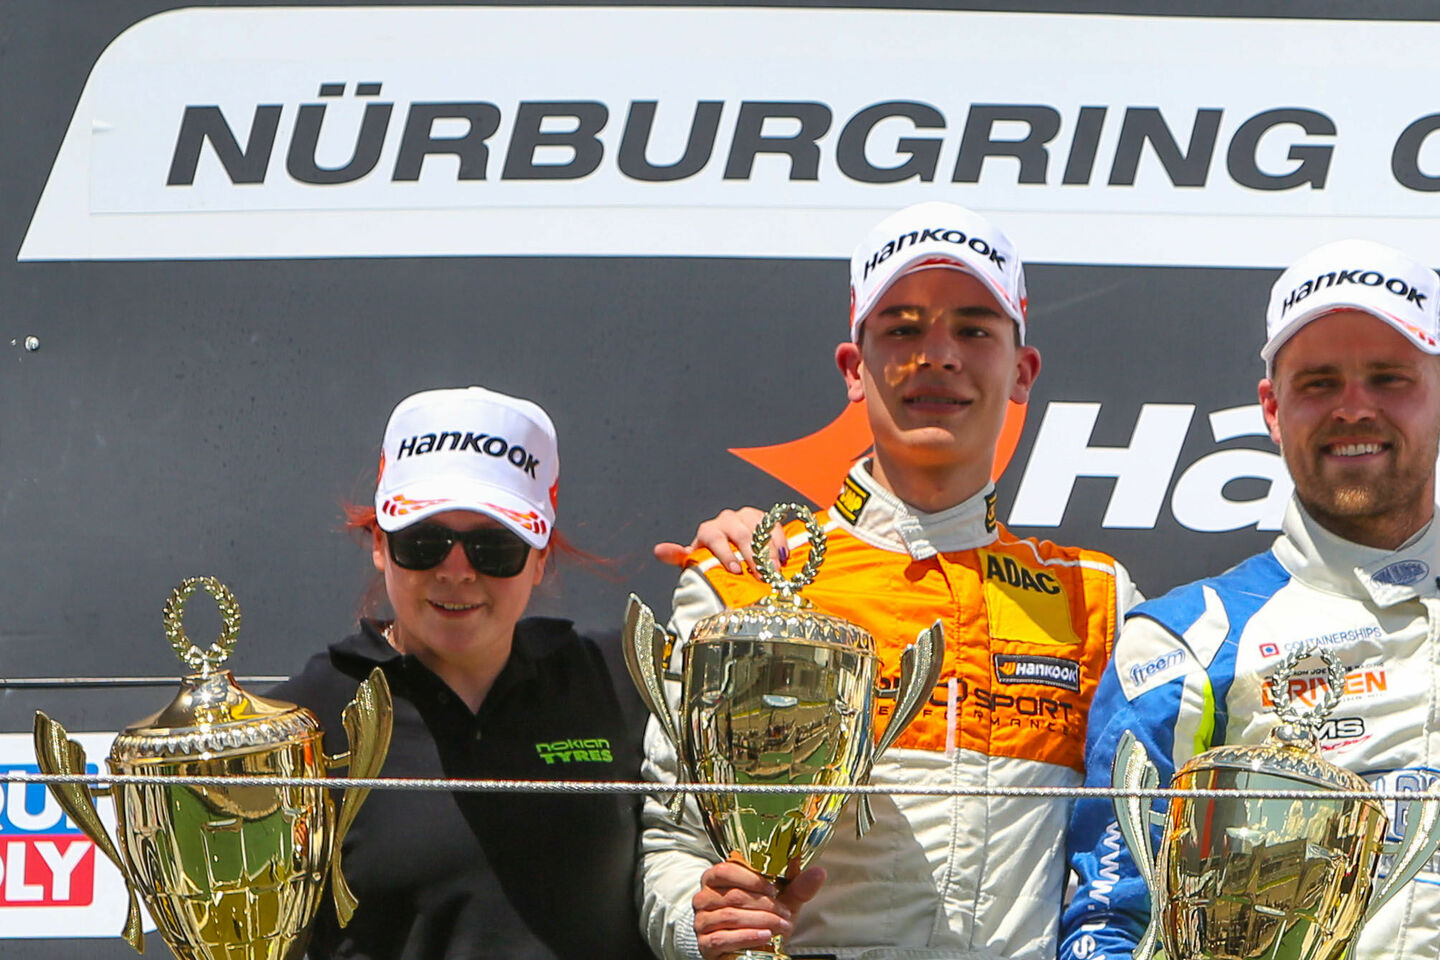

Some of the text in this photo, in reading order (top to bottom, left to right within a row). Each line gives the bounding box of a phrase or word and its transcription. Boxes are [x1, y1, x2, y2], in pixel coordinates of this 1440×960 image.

[166, 82, 1336, 191] NÜRBURGRING
[984, 553, 1061, 595] ADAC
[1130, 648, 1186, 687] freem
[973, 687, 1074, 723] SPORT
[536, 739, 611, 753] nokian
[540, 750, 614, 765] TYRES
